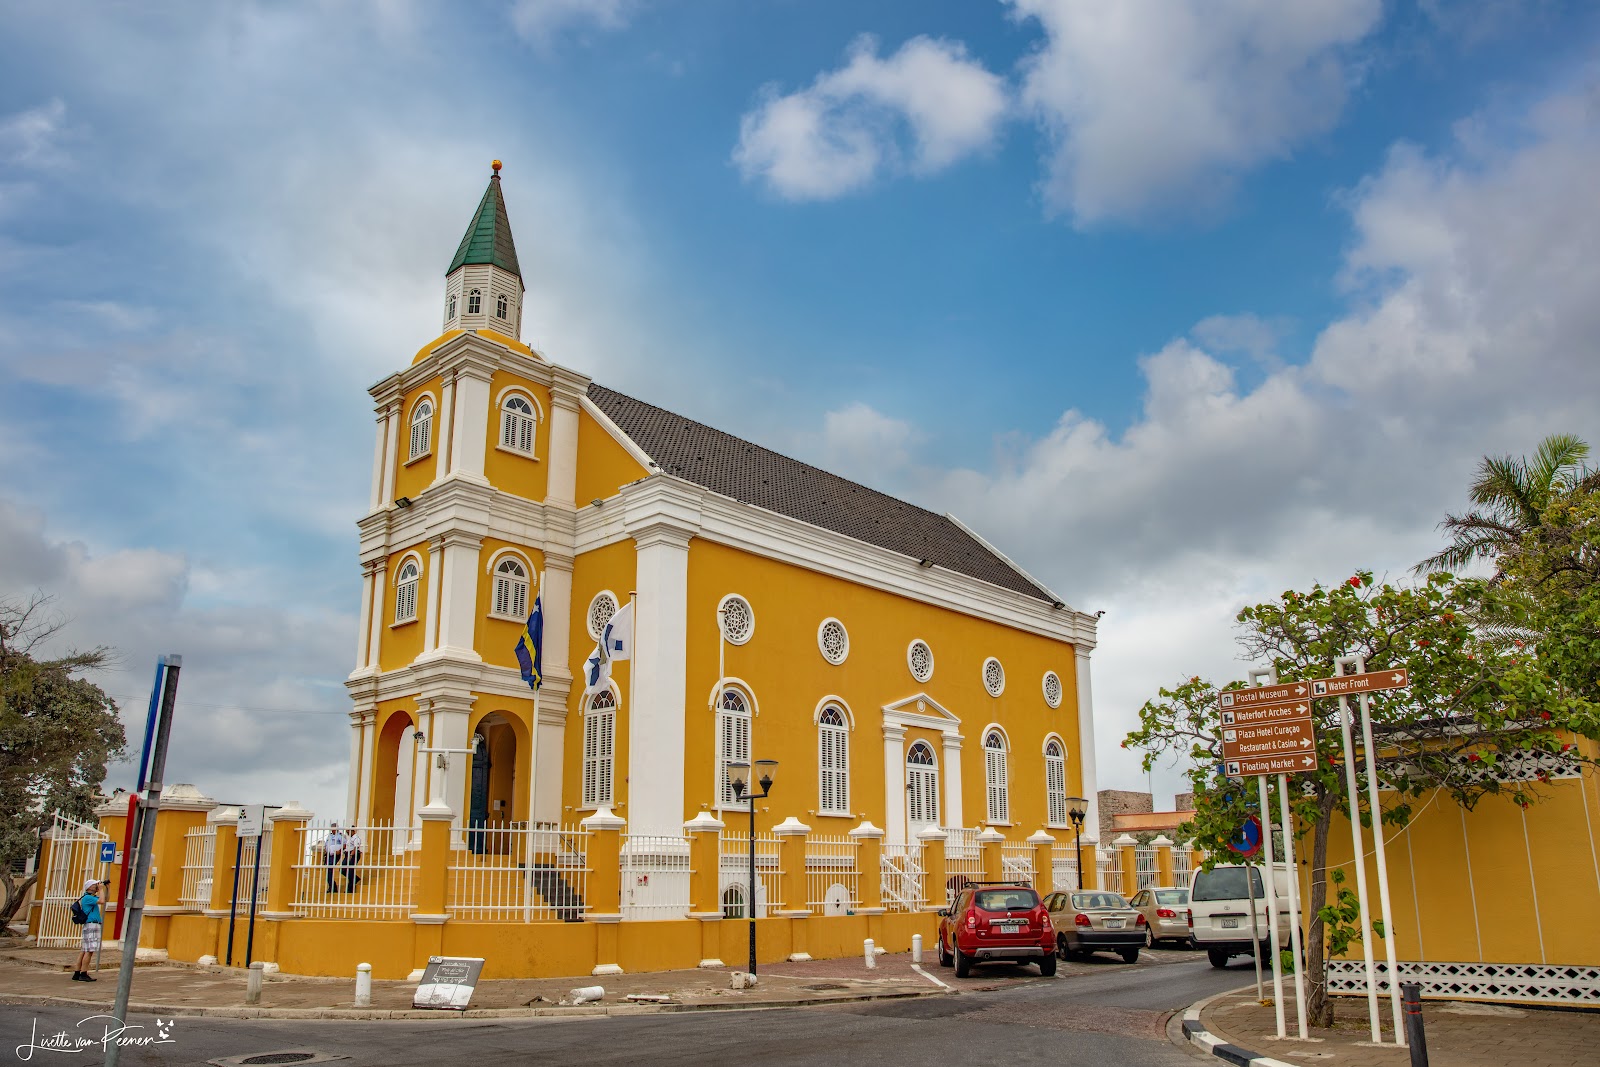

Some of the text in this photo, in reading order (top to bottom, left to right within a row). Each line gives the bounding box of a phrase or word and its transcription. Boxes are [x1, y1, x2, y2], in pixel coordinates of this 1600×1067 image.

[1328, 678, 1369, 691] Water Front
[1236, 689, 1289, 702] Postal Museum
[1236, 707, 1292, 721] Waterfort Arches
[1238, 725, 1300, 739] Plaza Hotel Curaçao
[1239, 739, 1298, 752] Restaurant & Casino
[1242, 759, 1295, 772] Floating Market
